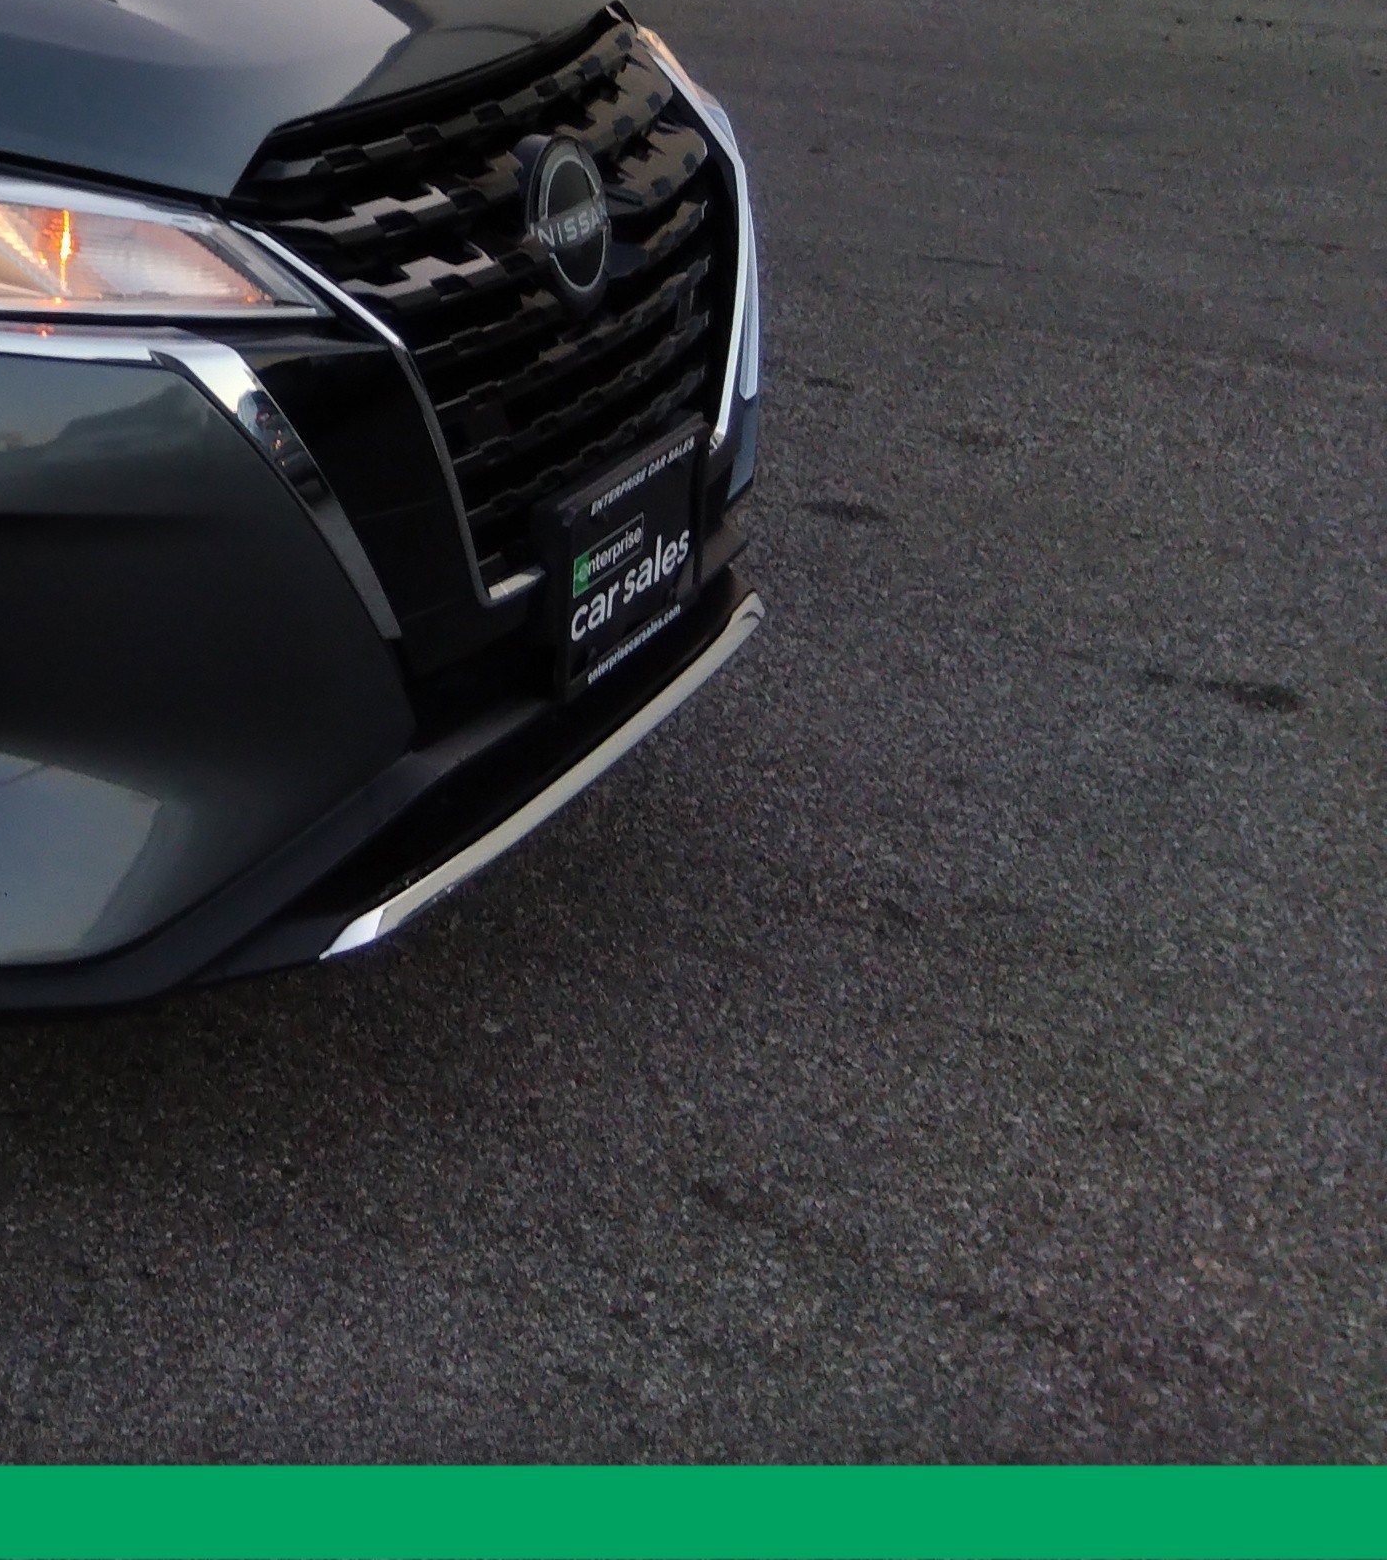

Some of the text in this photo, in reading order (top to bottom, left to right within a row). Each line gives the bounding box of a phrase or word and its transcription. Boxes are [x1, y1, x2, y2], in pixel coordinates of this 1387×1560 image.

[537, 200, 607, 247] NISSA
[647, 454, 667, 478] CAR
[667, 434, 695, 464] SALES
[576, 525, 643, 583] enterprise
[570, 529, 690, 642] car sales
